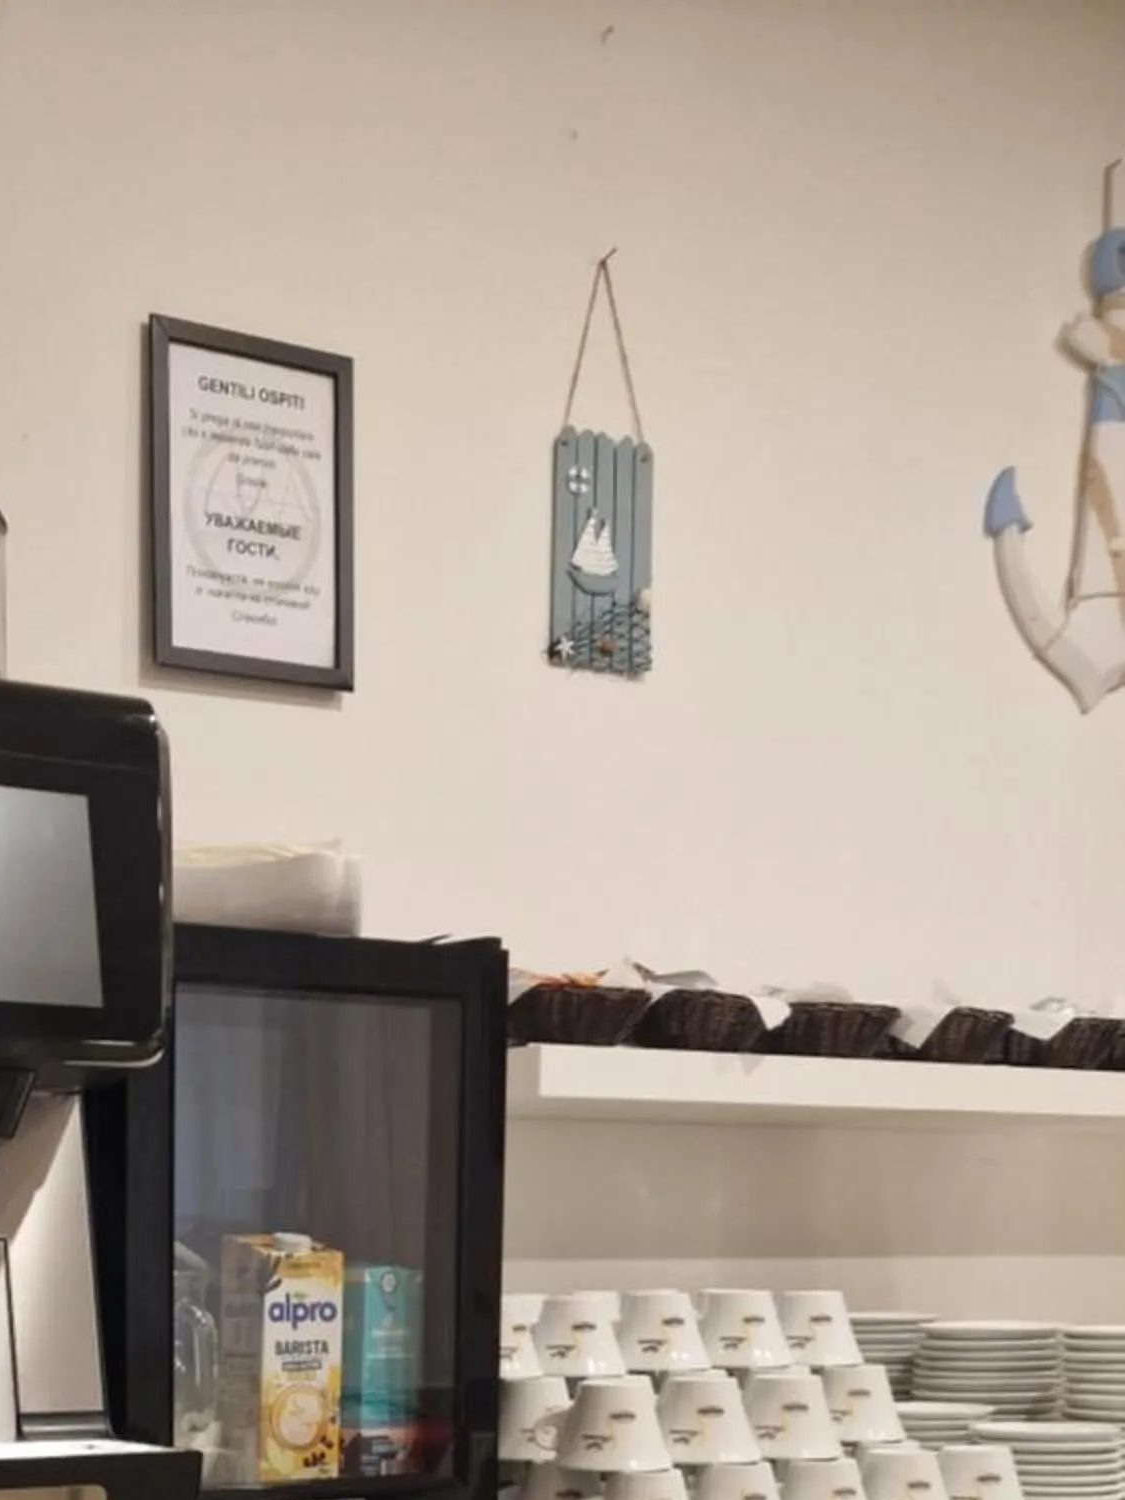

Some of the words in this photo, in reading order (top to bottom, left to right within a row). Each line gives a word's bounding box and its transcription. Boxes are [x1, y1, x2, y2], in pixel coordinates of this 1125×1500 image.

[197, 375, 256, 401] GENTILI
[258, 388, 305, 410] OSPITI
[268, 1292, 338, 1331] alpro
[275, 1340, 330, 1355] BARISTA
